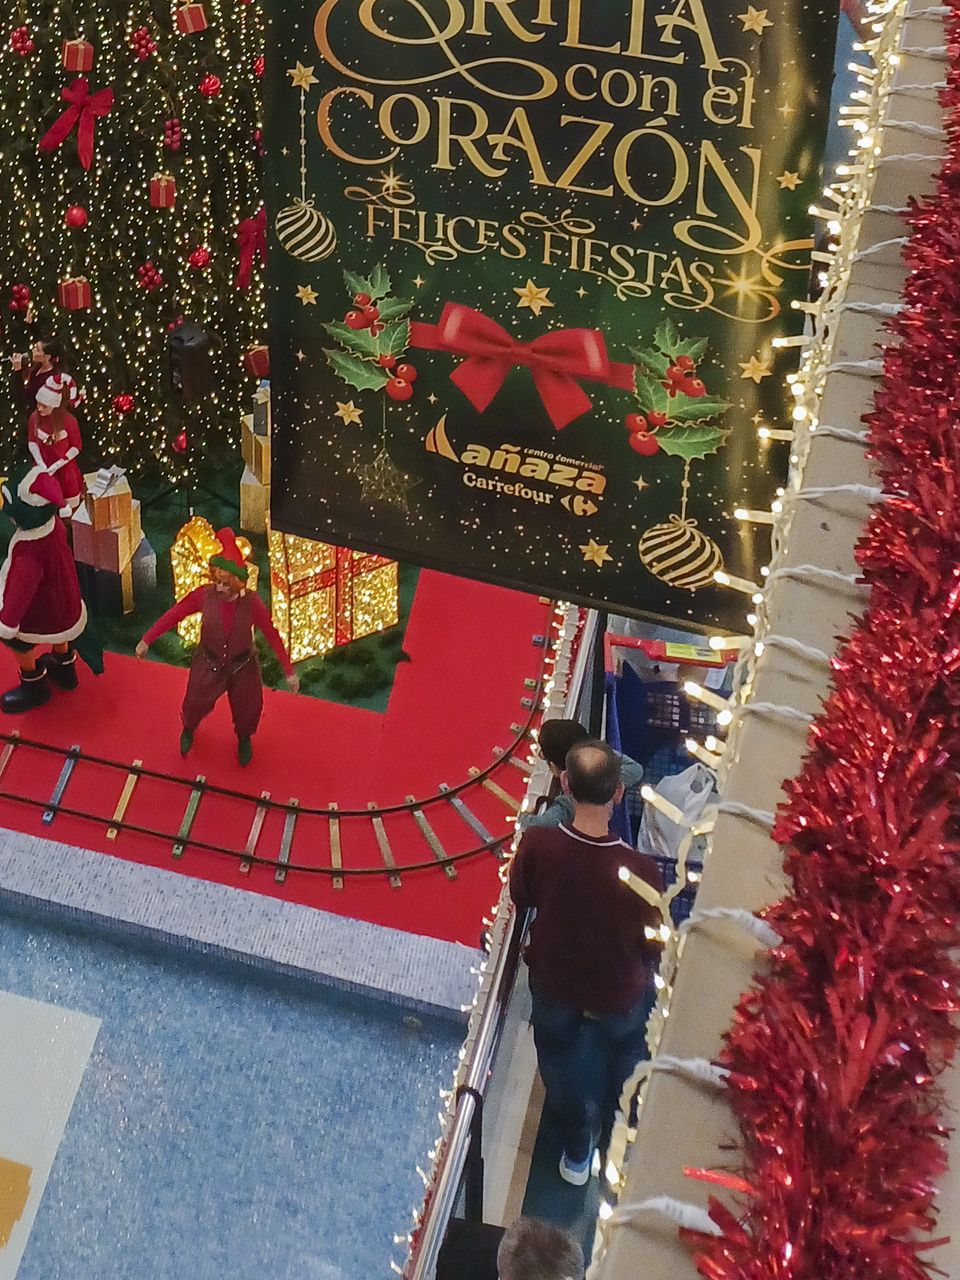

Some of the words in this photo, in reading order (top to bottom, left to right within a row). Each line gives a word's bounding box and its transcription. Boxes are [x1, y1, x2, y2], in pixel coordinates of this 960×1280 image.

[563, 61, 680, 117] con
[701, 72, 756, 129] el
[317, 86, 766, 240] CORAZÓN
[362, 202, 528, 264] FELICES
[541, 230, 720, 308] FIESTAS
[460, 443, 607, 495] añaza
[462, 472, 554, 505] Carrefour
[523, 446, 554, 460] centro
[555, 452, 602, 471] comercial
